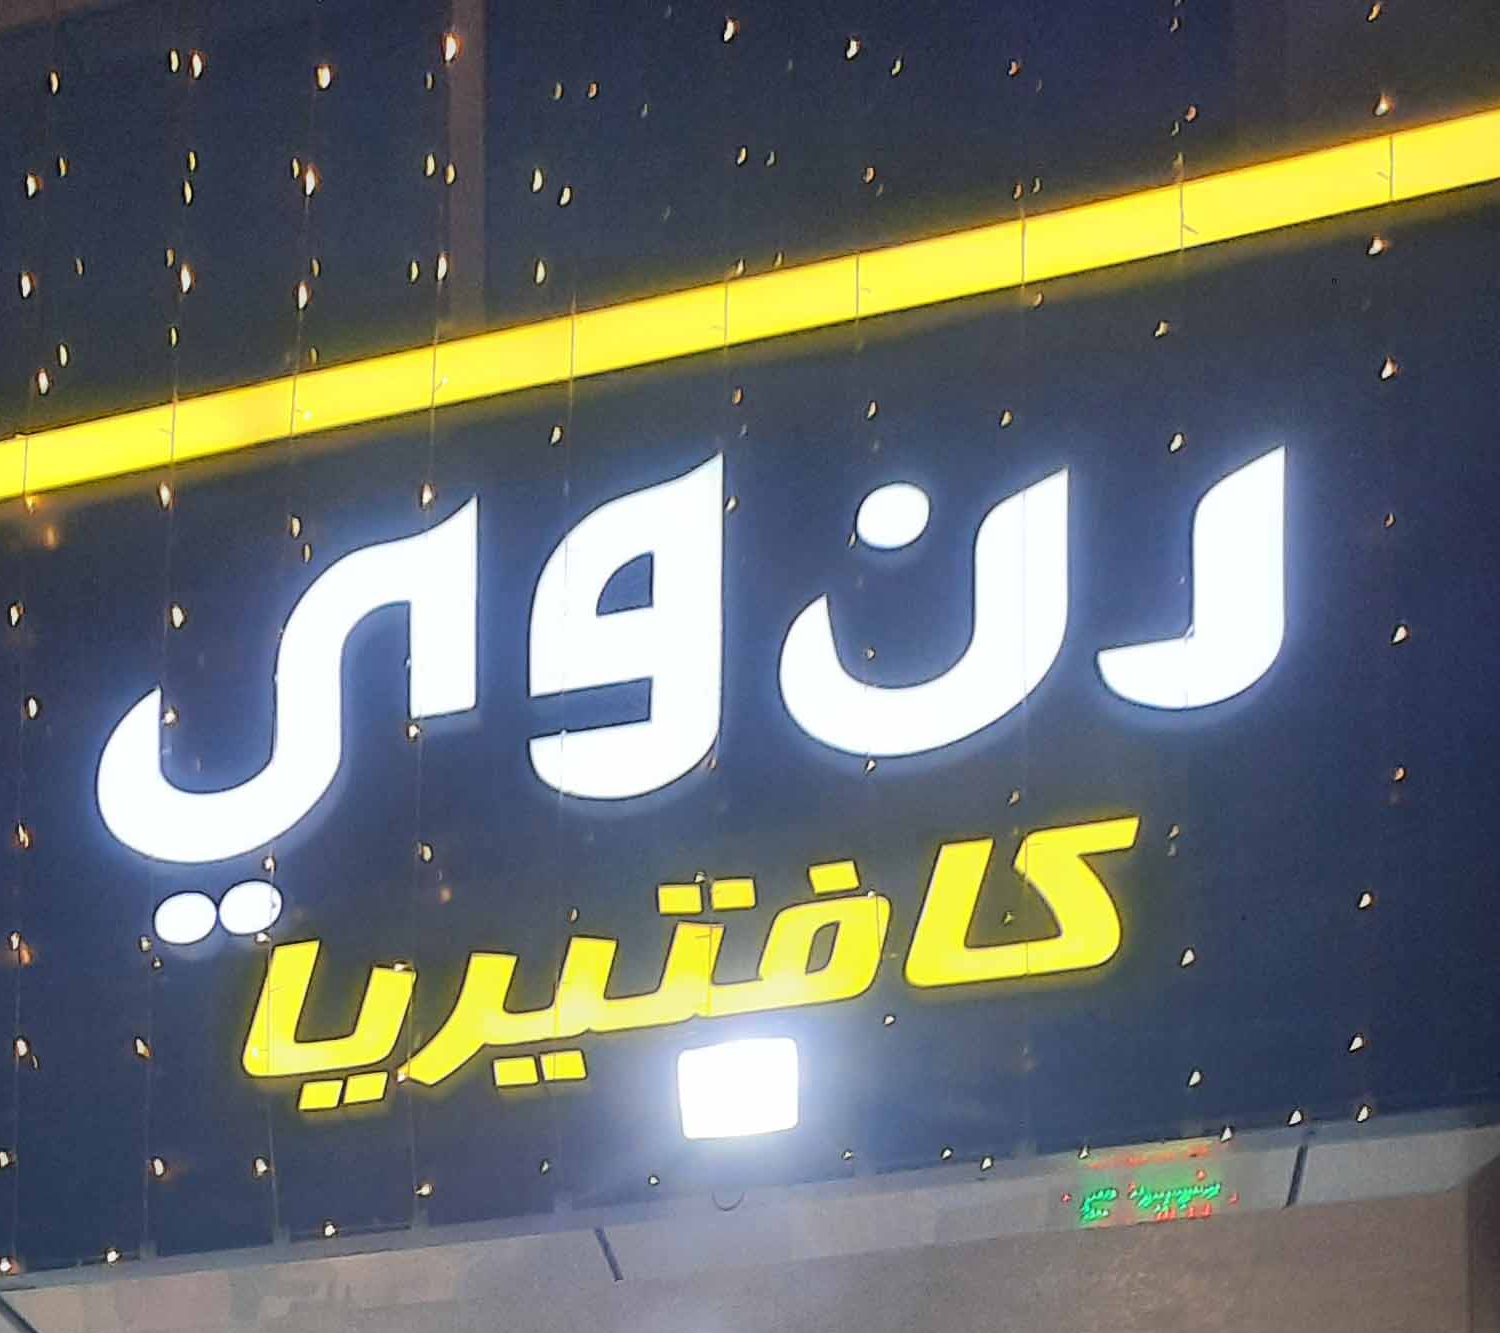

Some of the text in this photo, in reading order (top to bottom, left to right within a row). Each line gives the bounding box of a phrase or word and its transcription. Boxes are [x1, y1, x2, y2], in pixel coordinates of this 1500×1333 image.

[96, 445, 1288, 946] رن وي
[240, 815, 1142, 1110] كافتيريا
